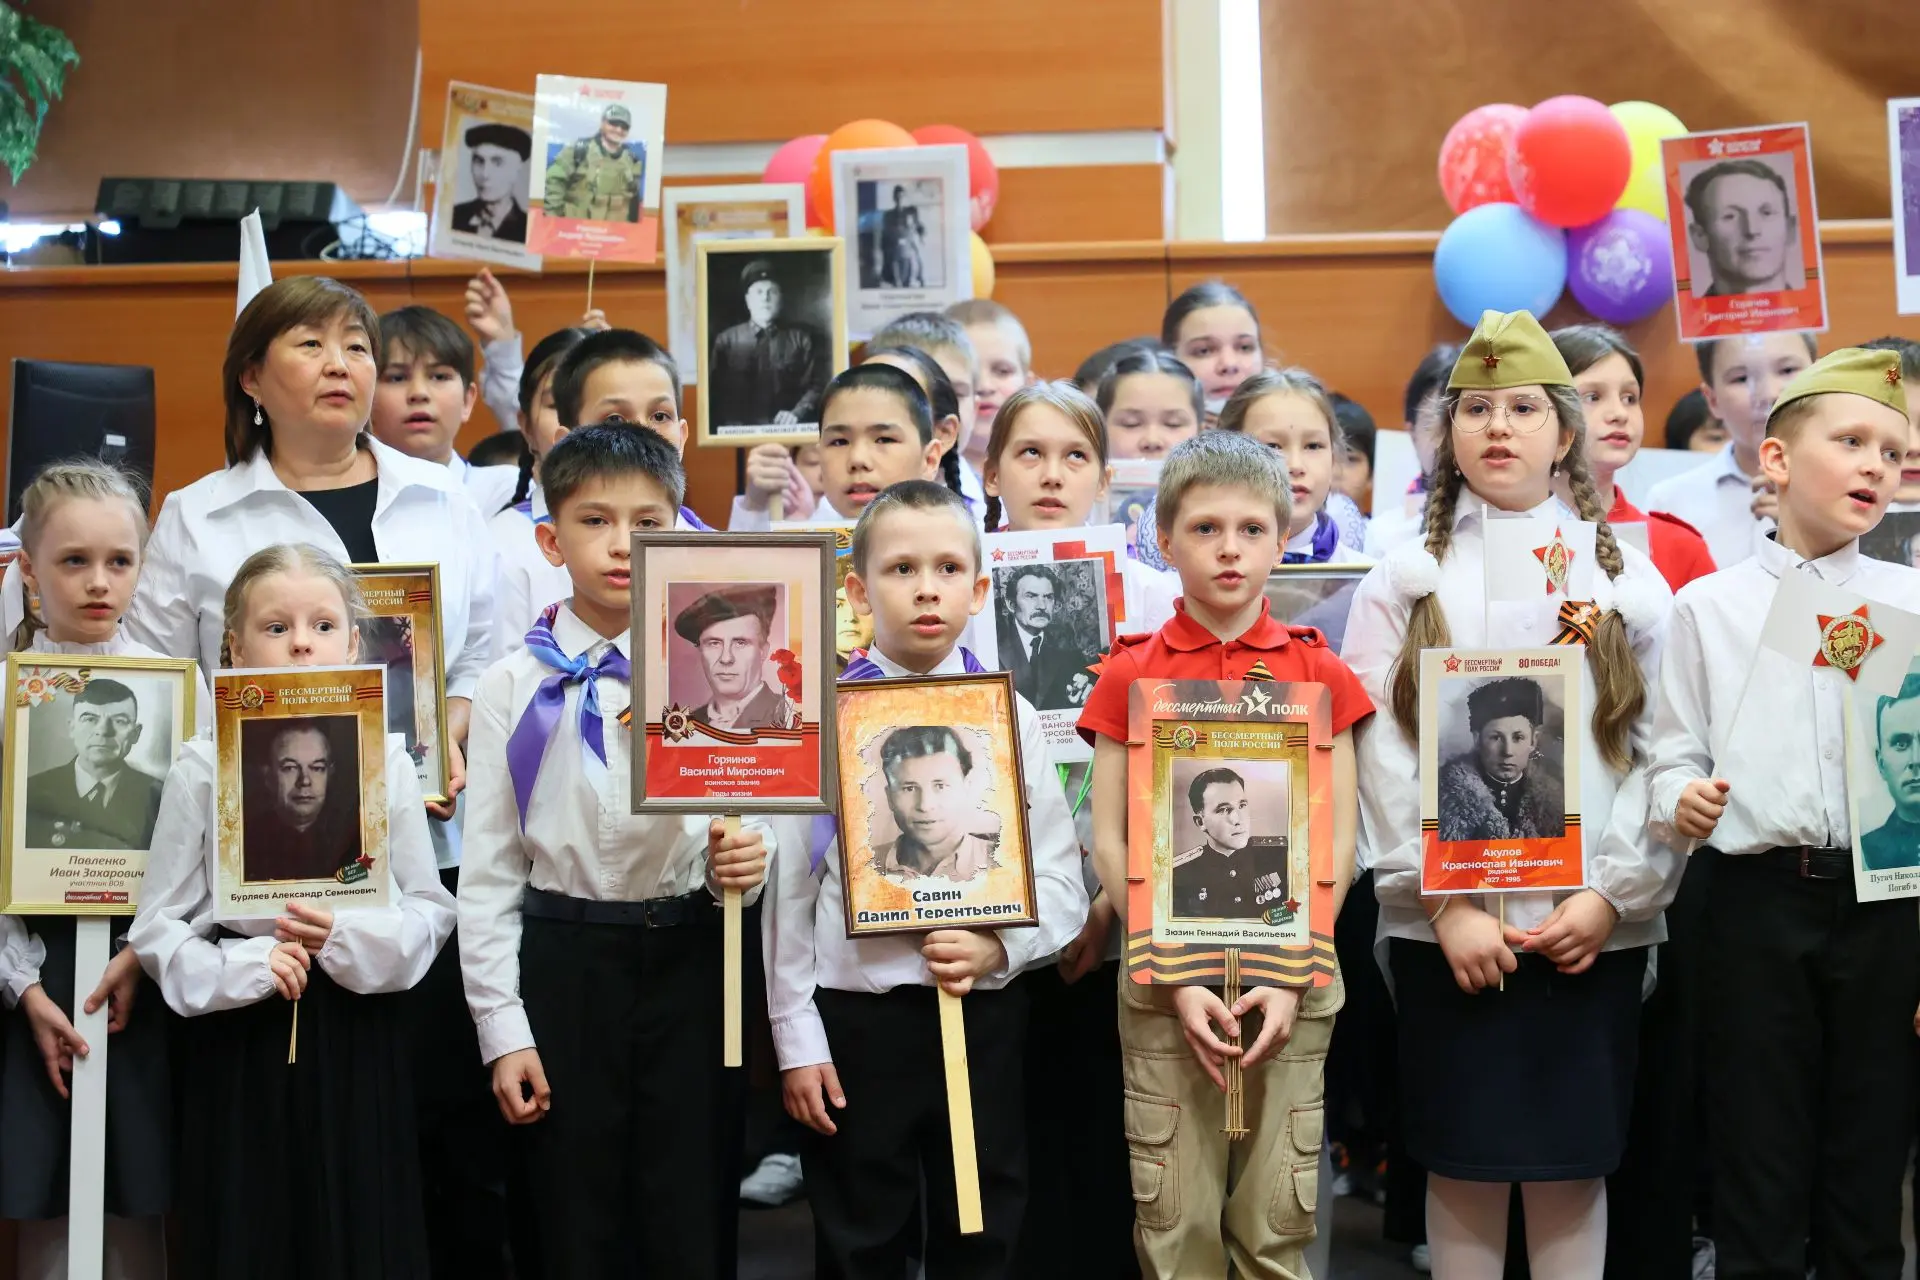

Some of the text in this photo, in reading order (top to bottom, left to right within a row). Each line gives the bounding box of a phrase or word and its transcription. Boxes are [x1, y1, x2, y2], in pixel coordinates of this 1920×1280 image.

[367, 598, 403, 606] РОССИИ
[1464, 657, 1503, 667] БЕССМЕРТНЫЙ
[1519, 658, 1561, 668] 80 ПОБЕДА!
[278, 684, 352, 697] БЕССМЕРТНЫЙ
[281, 694, 350, 705] ПОЛК РОССИИ
[1271, 704, 1309, 716] ПОЛК
[1211, 731, 1284, 742] БЕССМЕРТНЫЙ
[1214, 740, 1281, 749] ПОЛК РОССИИ
[708, 754, 757, 766] Горяинов
[679, 766, 785, 778] Василий Миронович
[1482, 848, 1522, 858] Акулов
[68, 855, 127, 866] Павленко
[1441, 858, 1563, 871] Краснослав Иванович
[49, 868, 145, 879] Иван Захарович
[1487, 868, 1518, 876] рядовой
[69, 880, 107, 888] участник
[1869, 874, 1893, 883] Пугач
[1888, 882, 1911, 892] Погиб
[230, 887, 377, 903] Бурляев Александр Семенович
[912, 890, 962, 903] Савин
[857, 903, 1022, 923] Данил Терентьевич
[1165, 928, 1297, 939] Зюзин Геннадий Васильевич
